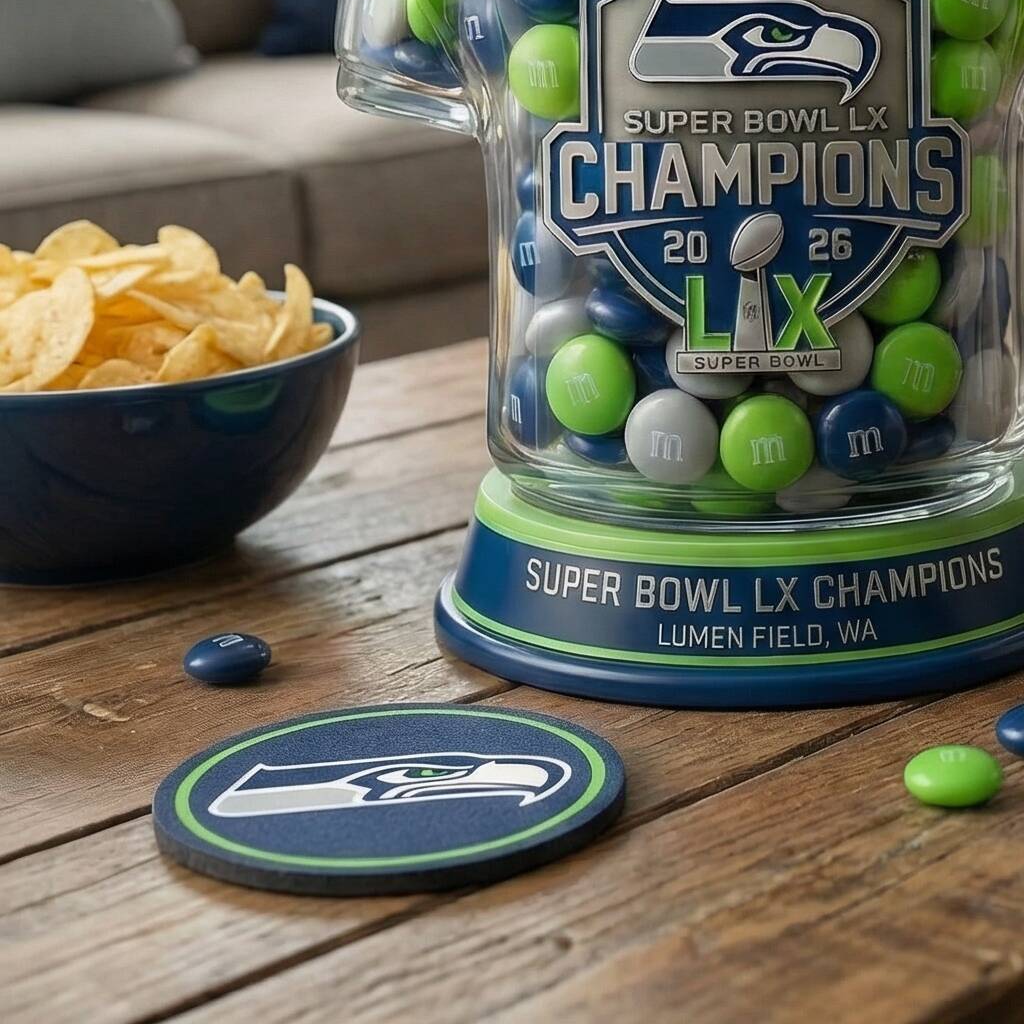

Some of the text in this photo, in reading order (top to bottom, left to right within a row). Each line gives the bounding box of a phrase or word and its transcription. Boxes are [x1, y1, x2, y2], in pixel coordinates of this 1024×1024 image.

[623, 106, 889, 135] SUPER BOWL LX
[559, 136, 956, 220] CHAMPIONS
[663, 228, 853, 265] 20 26
[693, 353, 826, 370] SUPER BOWL
[650, 429, 684, 463] m
[748, 432, 785, 466] m
[846, 426, 884, 459] m
[525, 547, 1005, 614] SUPER BOWL LX CHAMPIONS
[657, 617, 878, 650] LUMEN FIELD, WA
